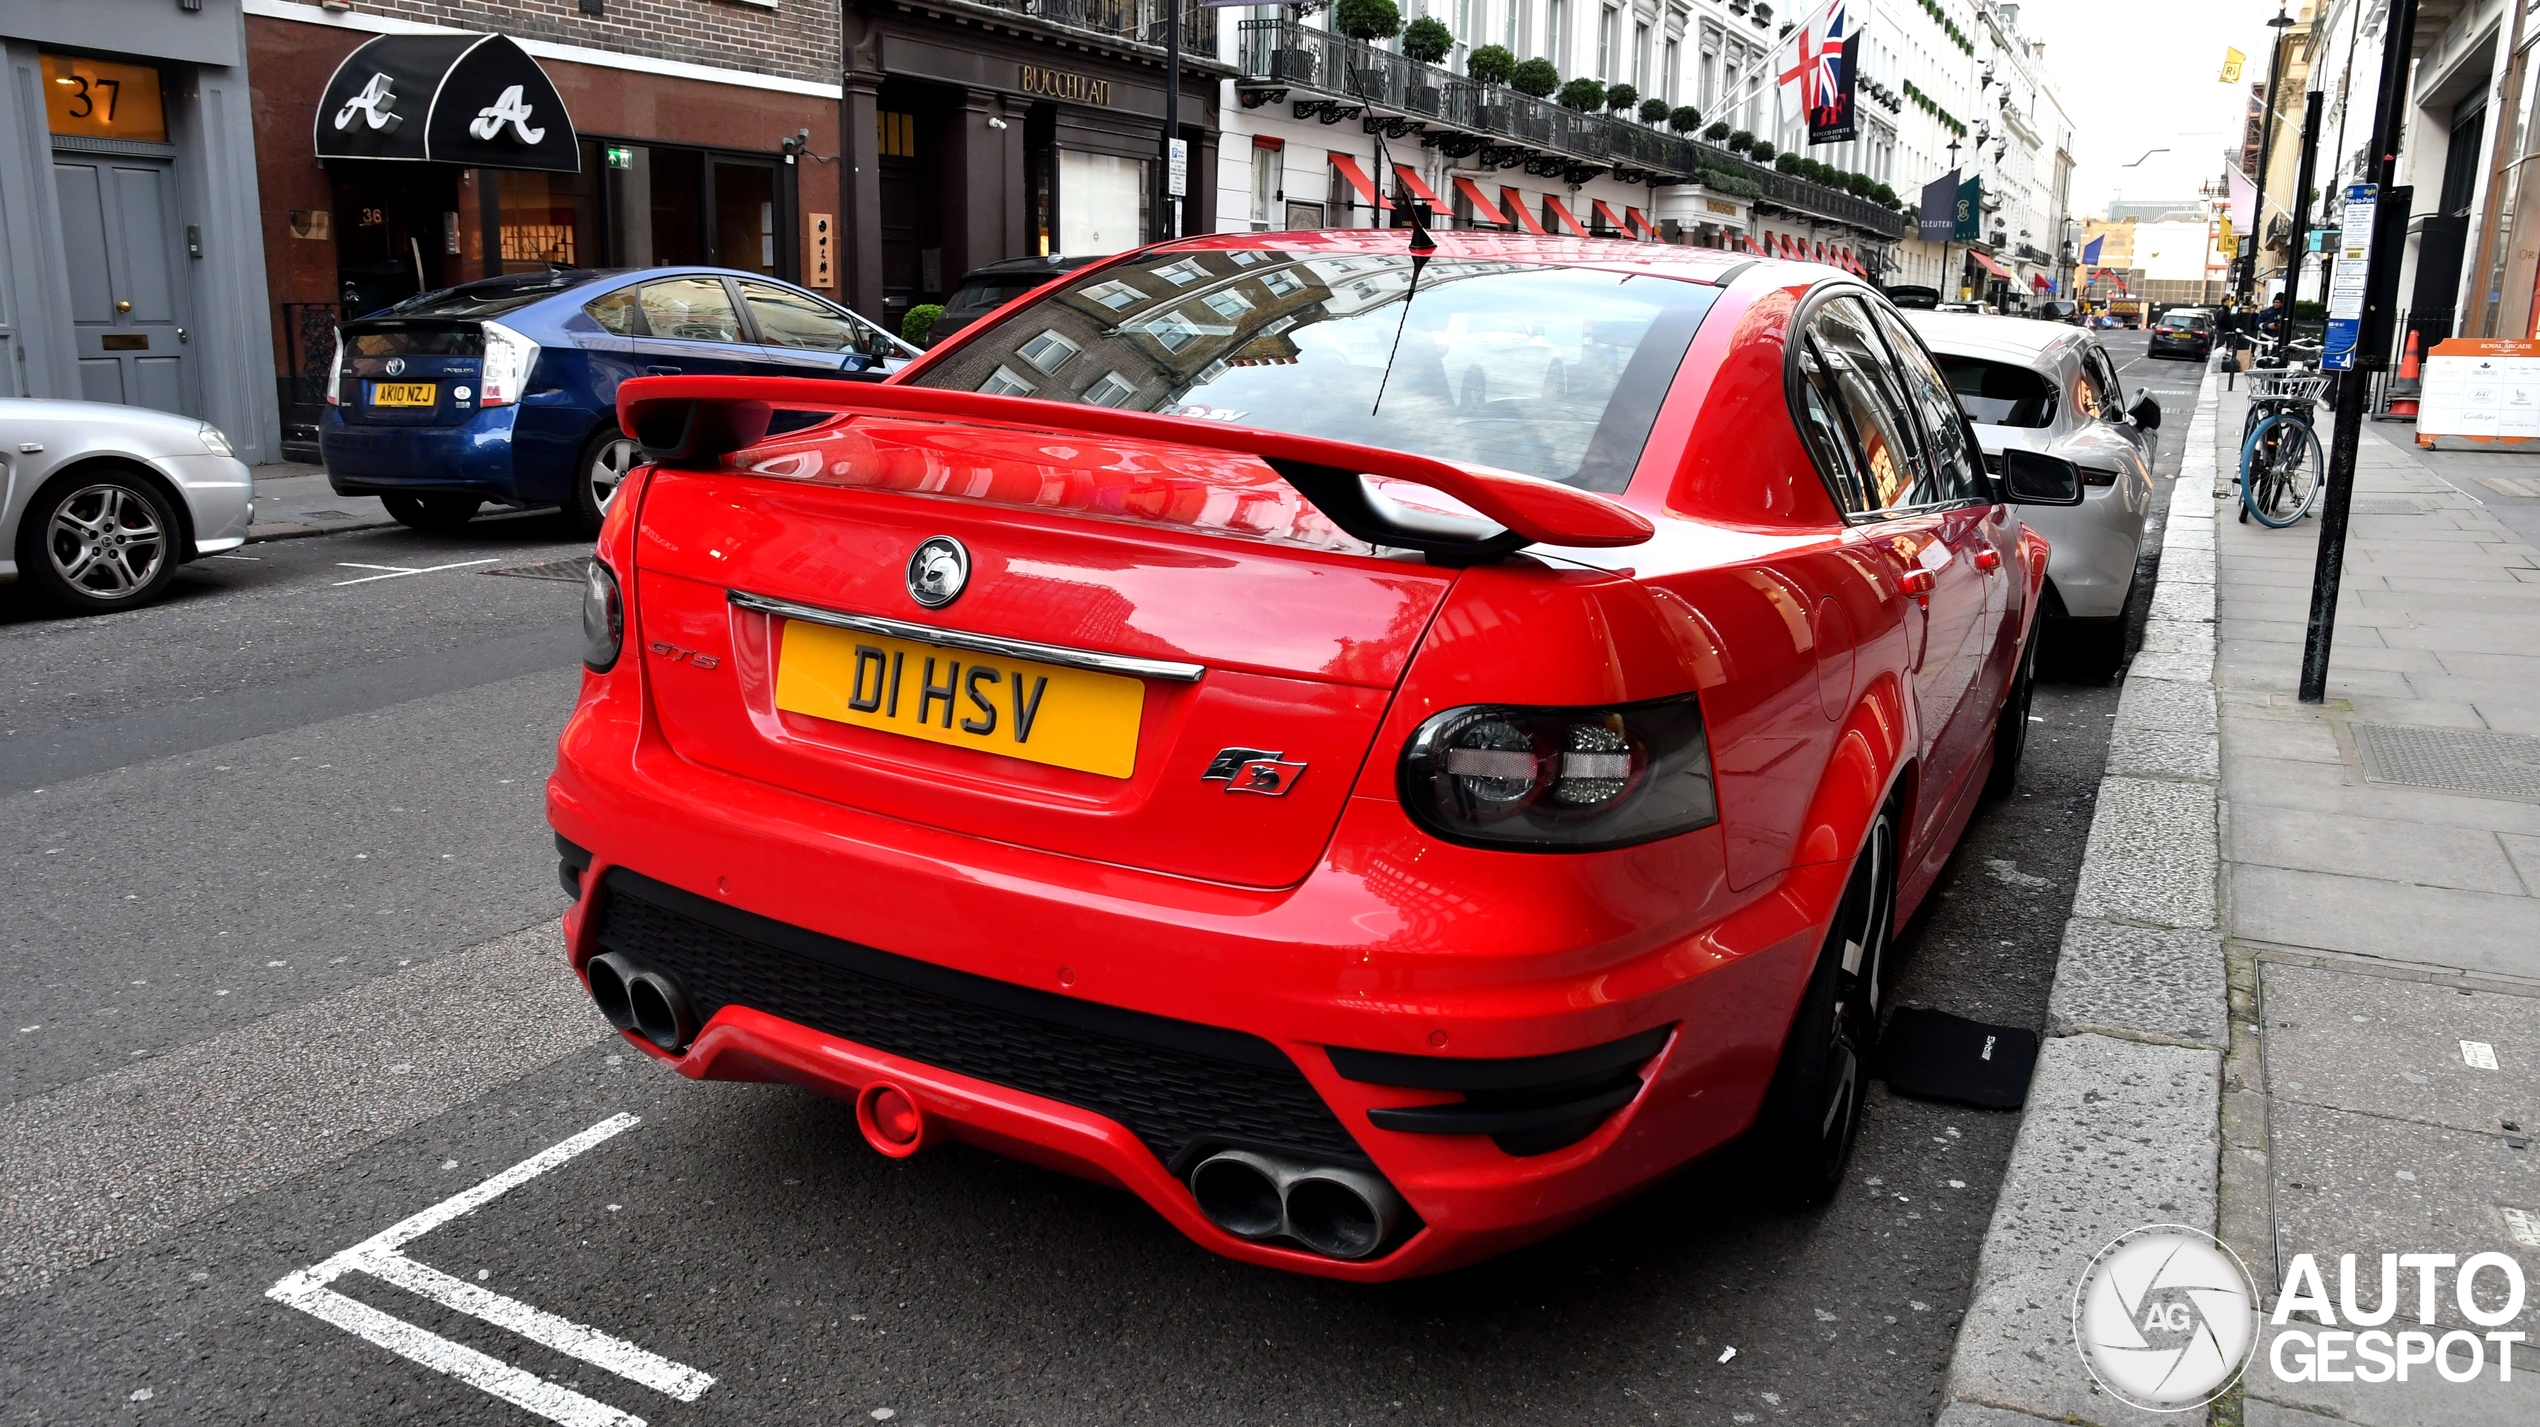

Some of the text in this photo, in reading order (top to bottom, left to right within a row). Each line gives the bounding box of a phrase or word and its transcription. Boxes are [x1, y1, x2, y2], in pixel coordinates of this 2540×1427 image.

[2226, 66, 2236, 75] Ri
[1023, 65, 1111, 104] BUCCELLATI
[68, 75, 120, 122] 37
[334, 72, 403, 134] A
[469, 84, 545, 145] A
[1820, 134, 1842, 142] HOTELS
[2345, 197, 2375, 205] Pay-to-Park
[362, 207, 382, 223] 36
[1921, 219, 1953, 228] ELEUTERI
[379, 384, 431, 402] AK10 NZJ
[647, 639, 720, 670] GTS
[916, 657, 1049, 744] HSV
